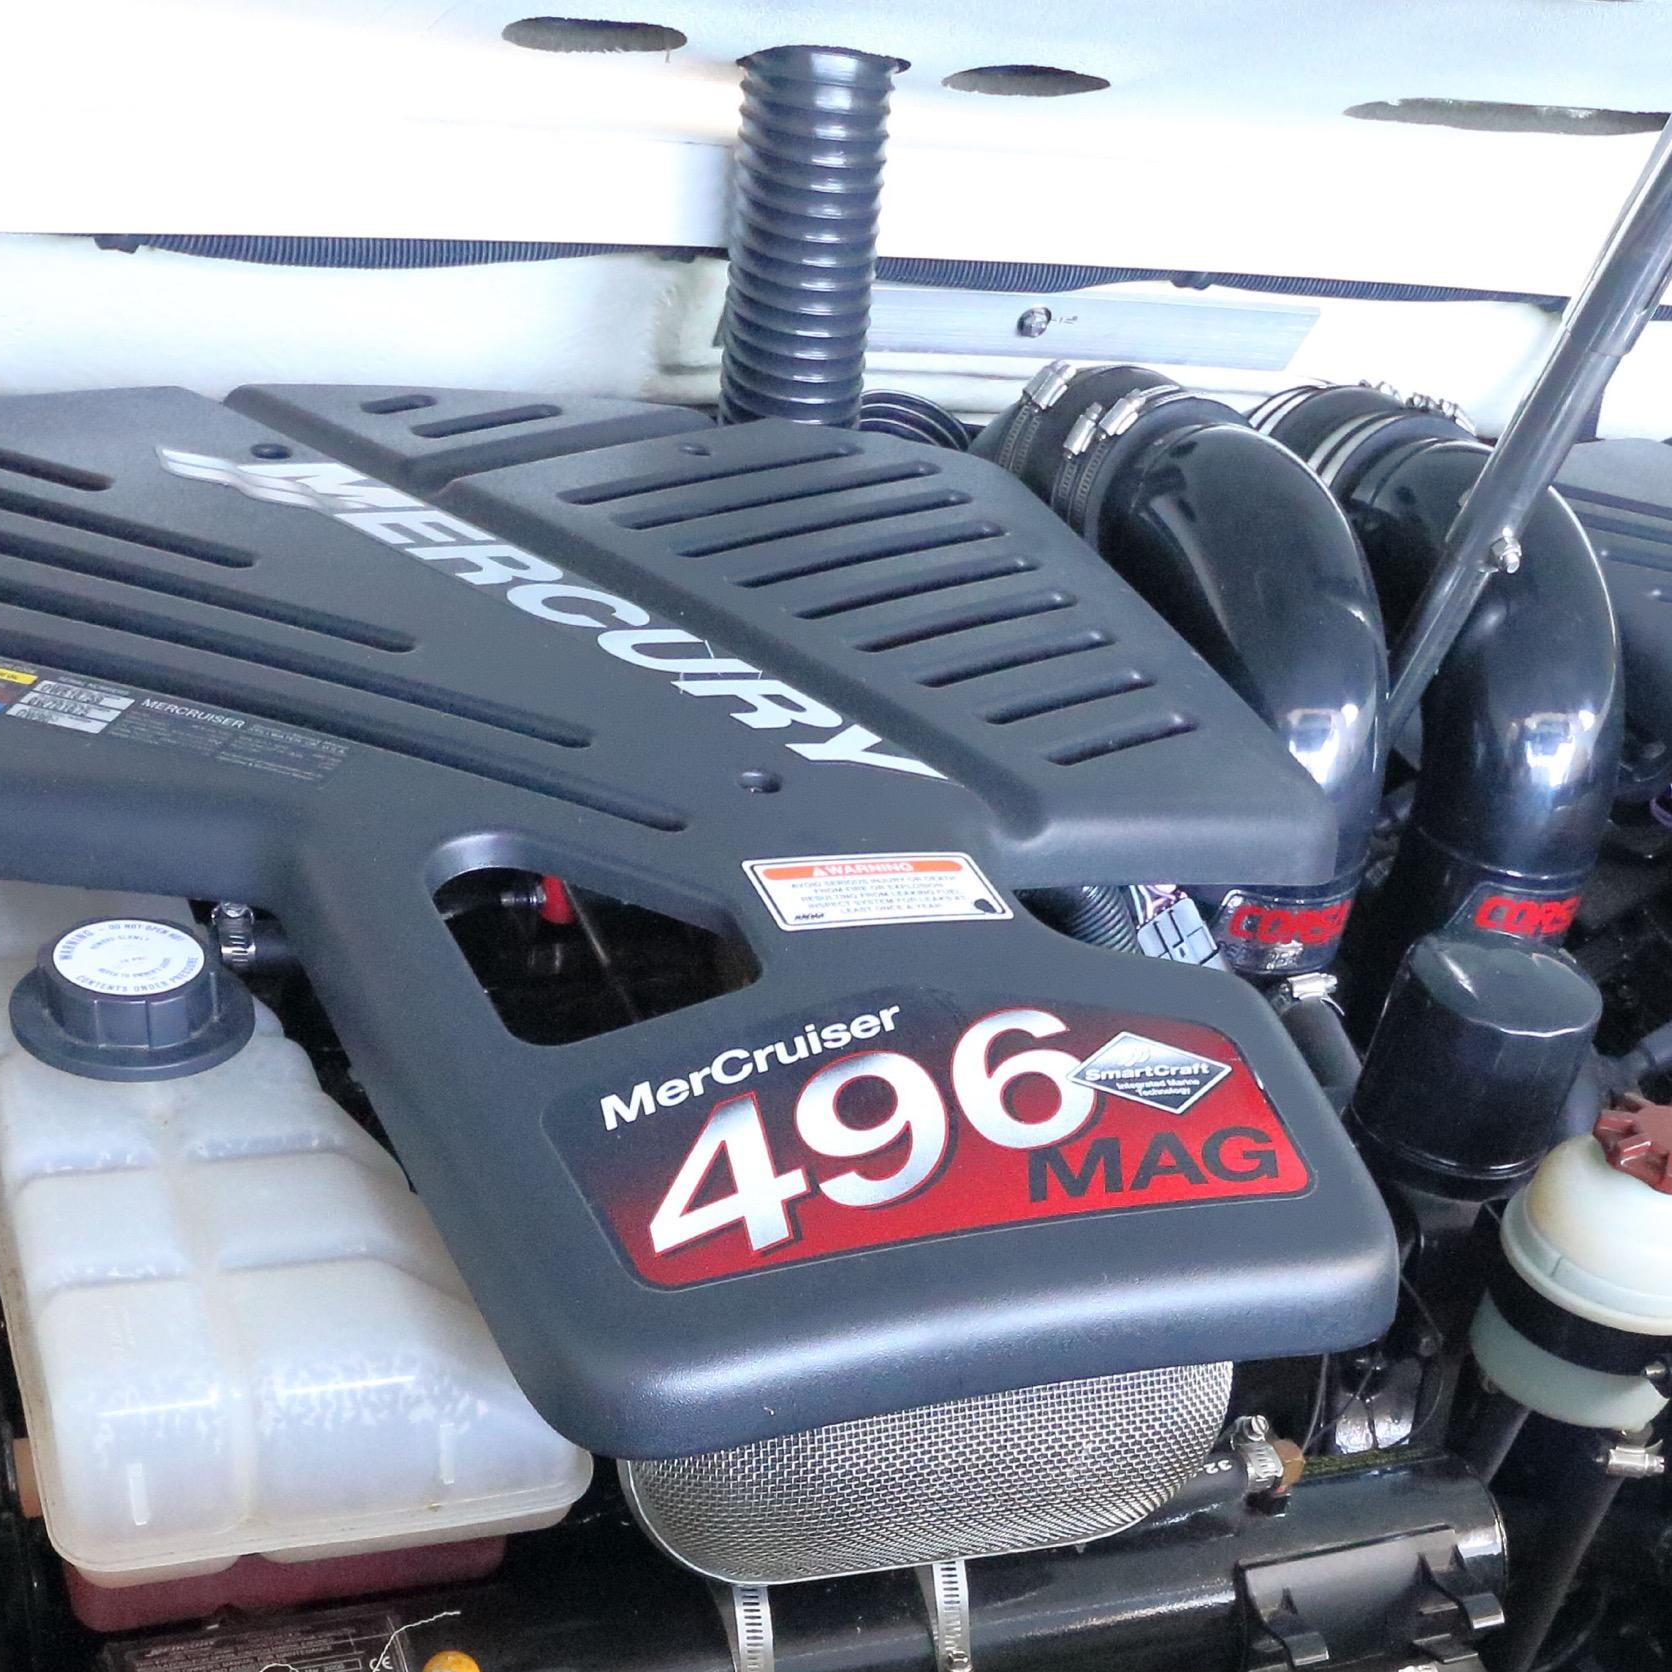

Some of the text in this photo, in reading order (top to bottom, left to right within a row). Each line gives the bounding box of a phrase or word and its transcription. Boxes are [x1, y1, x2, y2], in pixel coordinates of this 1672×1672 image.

[236, 462, 948, 780] MERCURY
[141, 699, 245, 728] MERCRUISER
[826, 862, 914, 877] WARNING
[58, 930, 95, 961] WARNING
[76, 974, 129, 993] CONTENTS
[133, 981, 169, 993] UNDER
[601, 1005, 900, 1131] MerCruiser
[1085, 1063, 1210, 1081] SmartCraft
[1116, 1079, 1200, 1090] Integrated Marine
[1135, 1087, 1191, 1097] Technology
[649, 1009, 1096, 1253] 496
[1030, 1126, 1279, 1203] MAG
